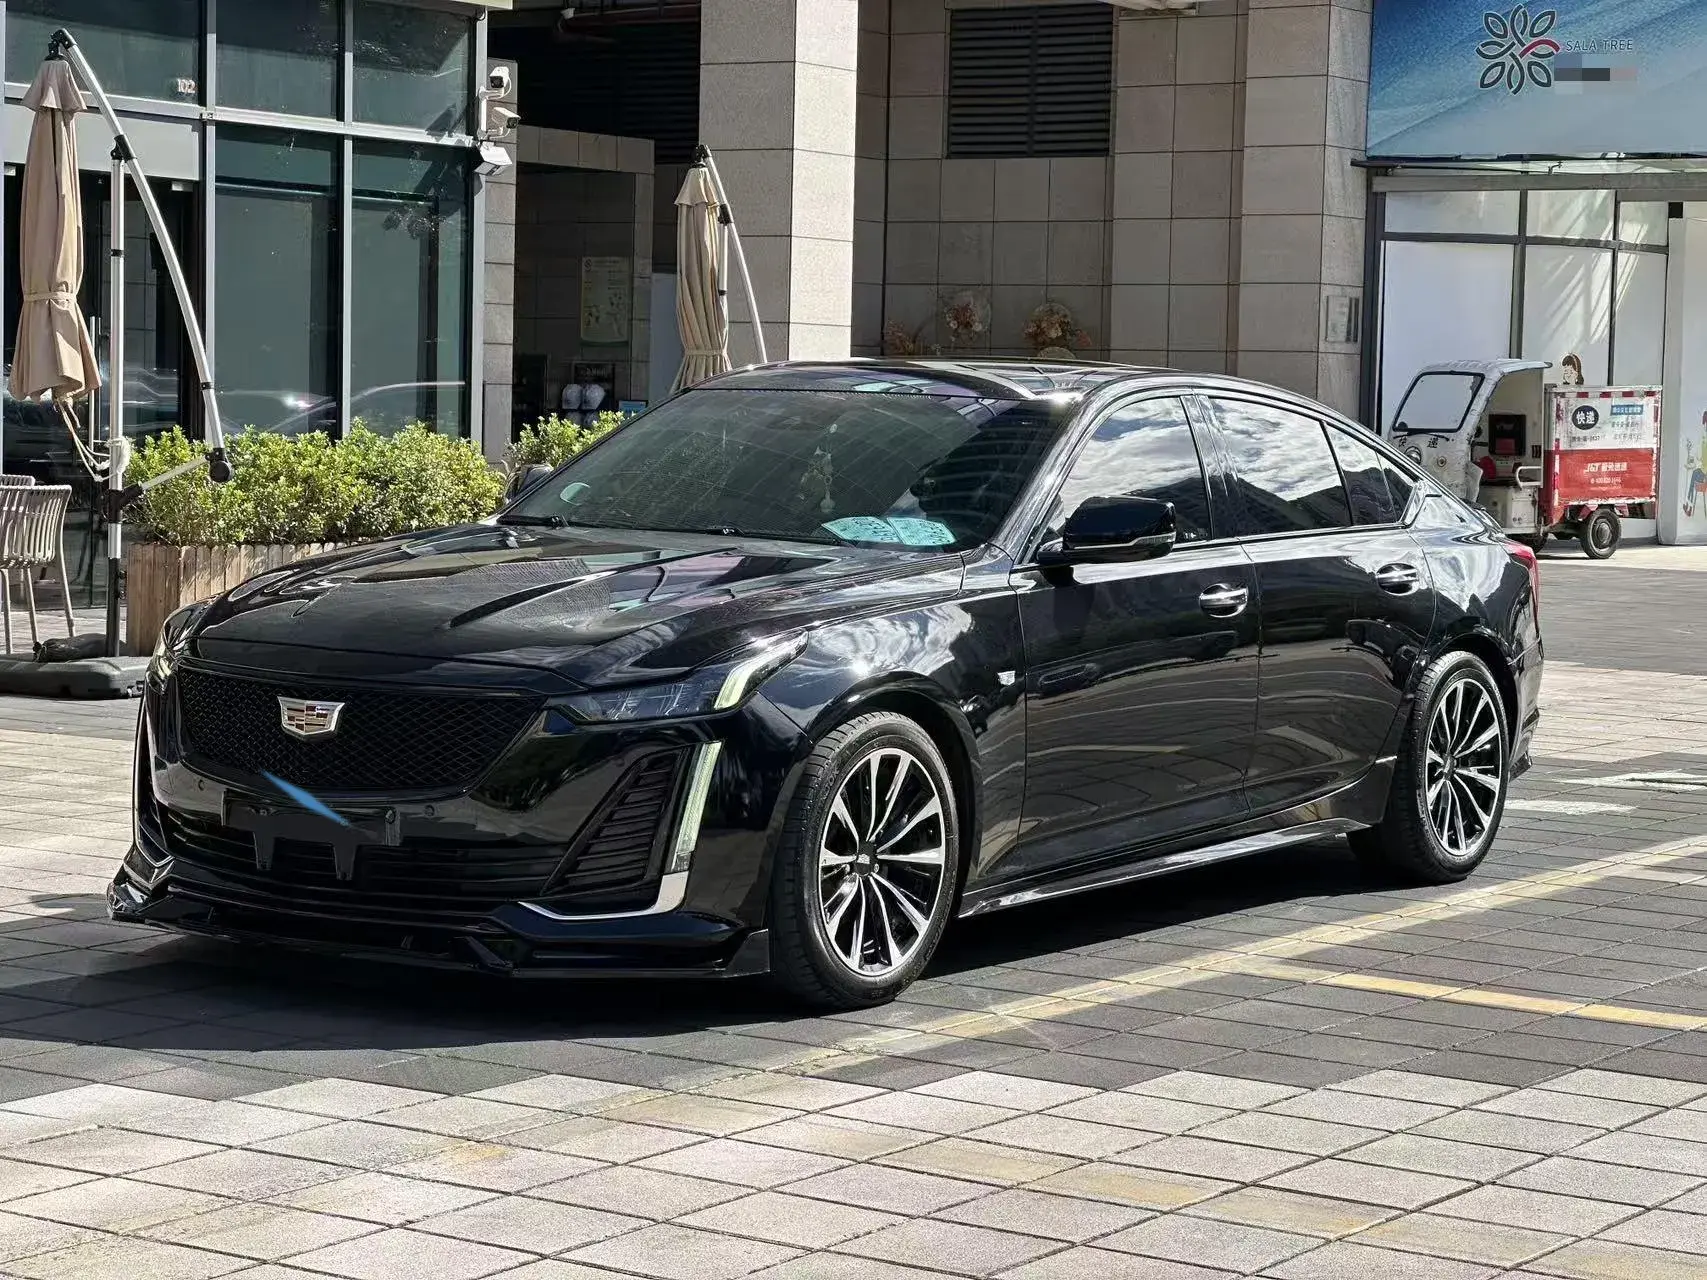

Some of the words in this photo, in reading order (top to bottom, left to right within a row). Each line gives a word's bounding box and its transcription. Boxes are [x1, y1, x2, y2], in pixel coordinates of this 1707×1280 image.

[1566, 39, 1597, 51] SALA
[1603, 39, 1633, 51] TREE
[176, 78, 195, 94] 102
[1576, 410, 1595, 424] 快递
